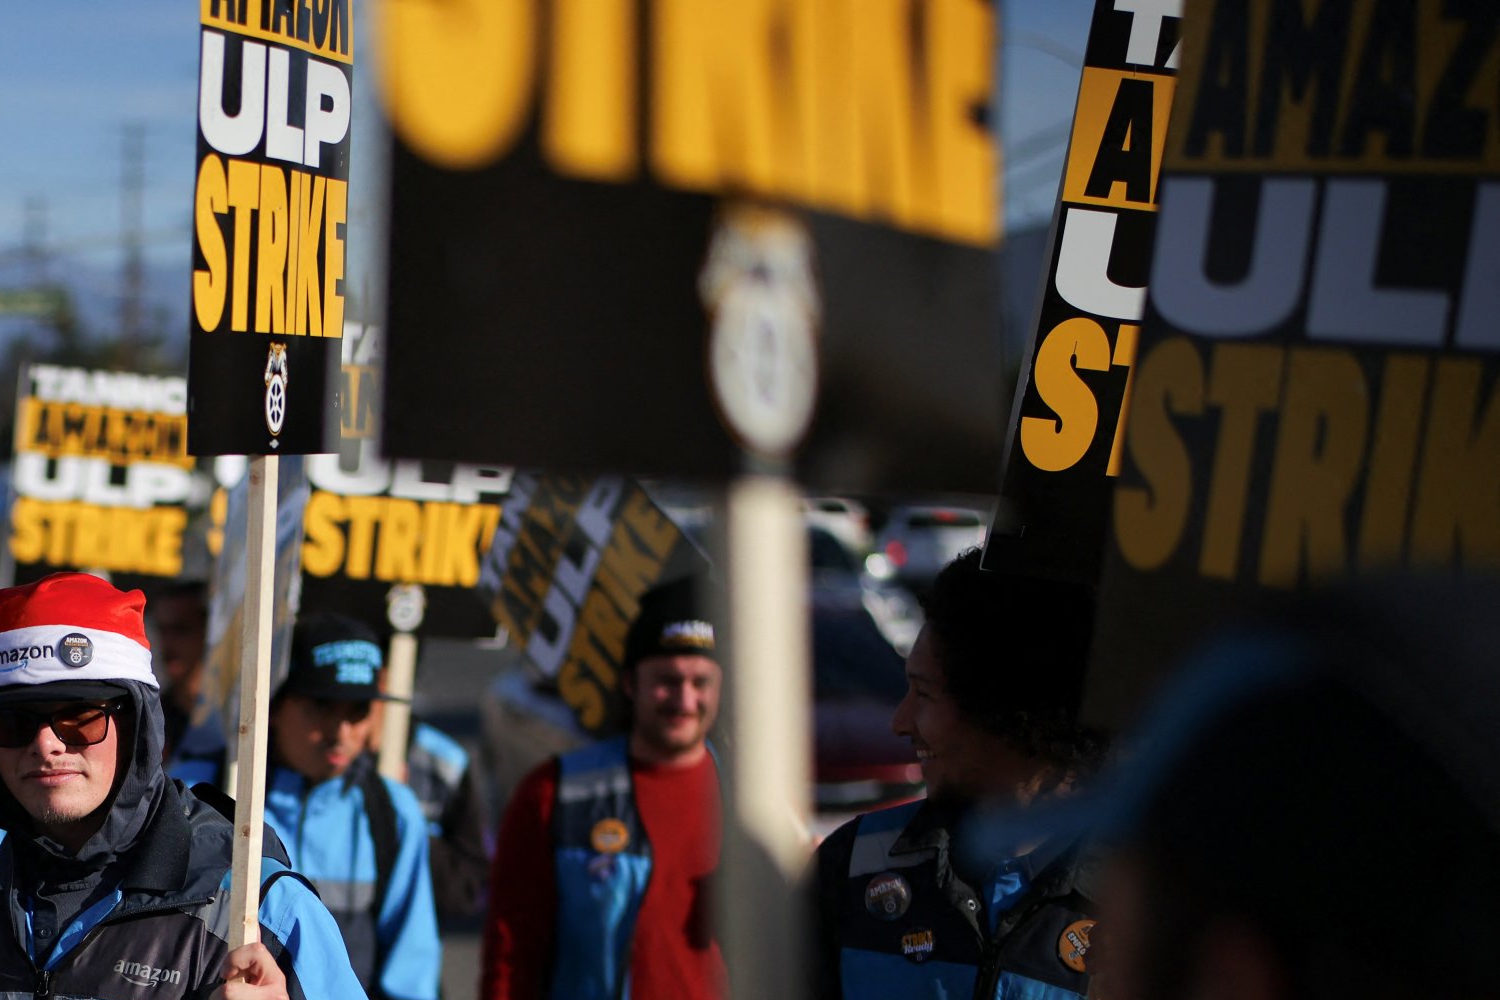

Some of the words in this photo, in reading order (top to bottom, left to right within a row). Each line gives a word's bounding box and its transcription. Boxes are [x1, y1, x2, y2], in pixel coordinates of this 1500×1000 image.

[200, 30, 350, 168] ULP
[193, 153, 347, 339] STRIKE
[28, 364, 187, 416] TANNC
[35, 405, 185, 462] AMAZON
[15, 451, 191, 508] ULP
[8, 496, 188, 577] STRIKE
[302, 490, 501, 588] STRIK
[65, 636, 88, 644] AMAZON
[113, 959, 181, 985] amazon
